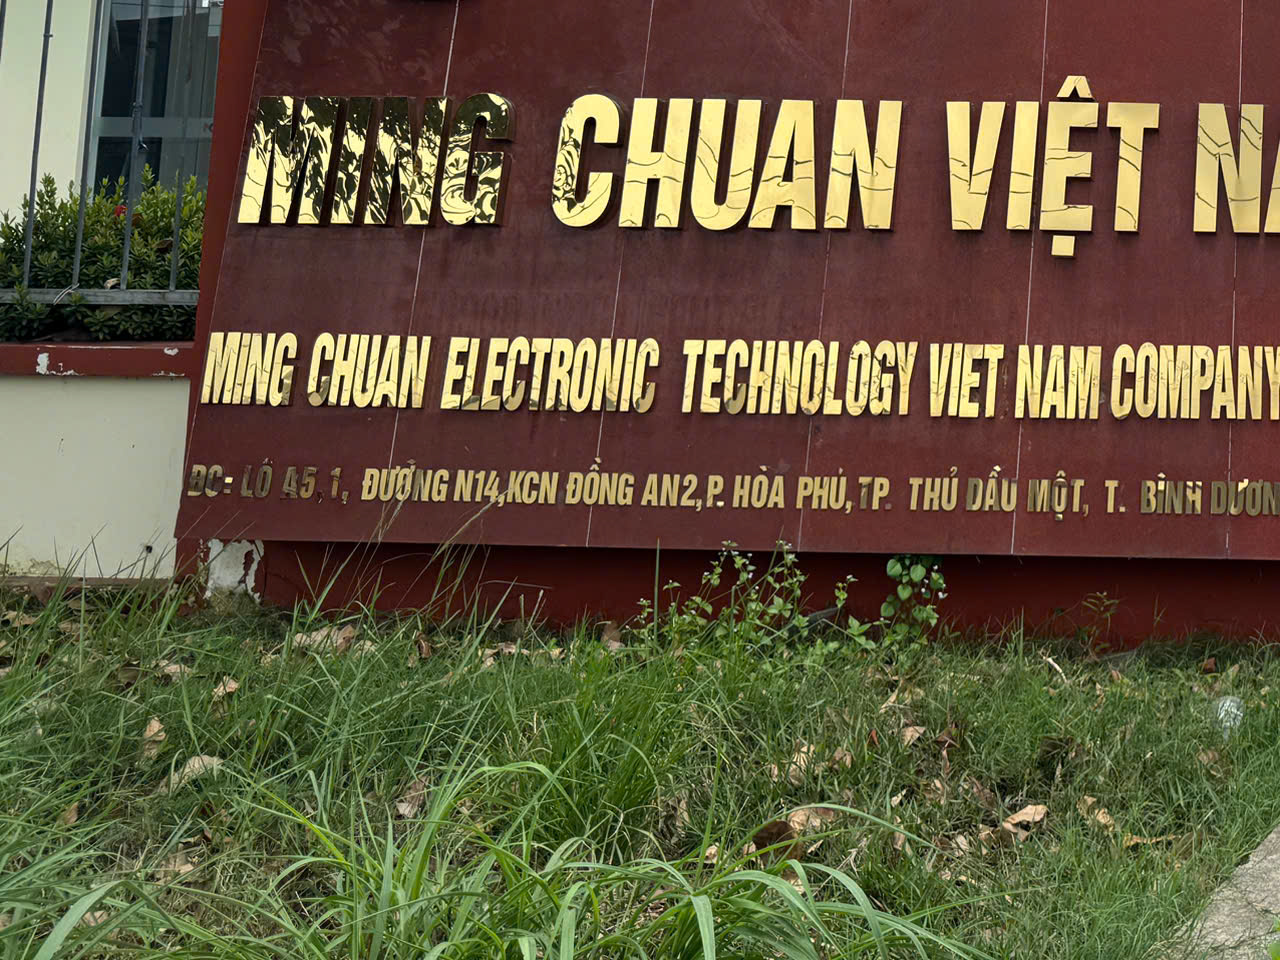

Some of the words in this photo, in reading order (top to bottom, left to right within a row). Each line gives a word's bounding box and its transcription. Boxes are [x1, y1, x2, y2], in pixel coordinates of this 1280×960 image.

[238, 92, 513, 225] MING
[551, 93, 902, 230] CHUAN
[946, 75, 1160, 257] VIỆT
[200, 331, 298, 407] MING
[306, 332, 432, 409] CHUAN
[440, 336, 660, 413] ELECTRONIC
[681, 338, 918, 416] TECHNOLOGY
[929, 343, 1005, 418] VIET
[1014, 344, 1102, 420] NAM
[240, 457, 273, 498] LÔ
[361, 458, 450, 502] ĐƯỜNG
[565, 457, 635, 507] ĐỒNG
[732, 465, 786, 509] HÒA
[909, 466, 959, 511] THỦ
[966, 464, 1019, 512] DẦU
[1027, 470, 1089, 521] MỘT,
[1104, 479, 1127, 513] T.
[1140, 472, 1203, 515] BÌNH
